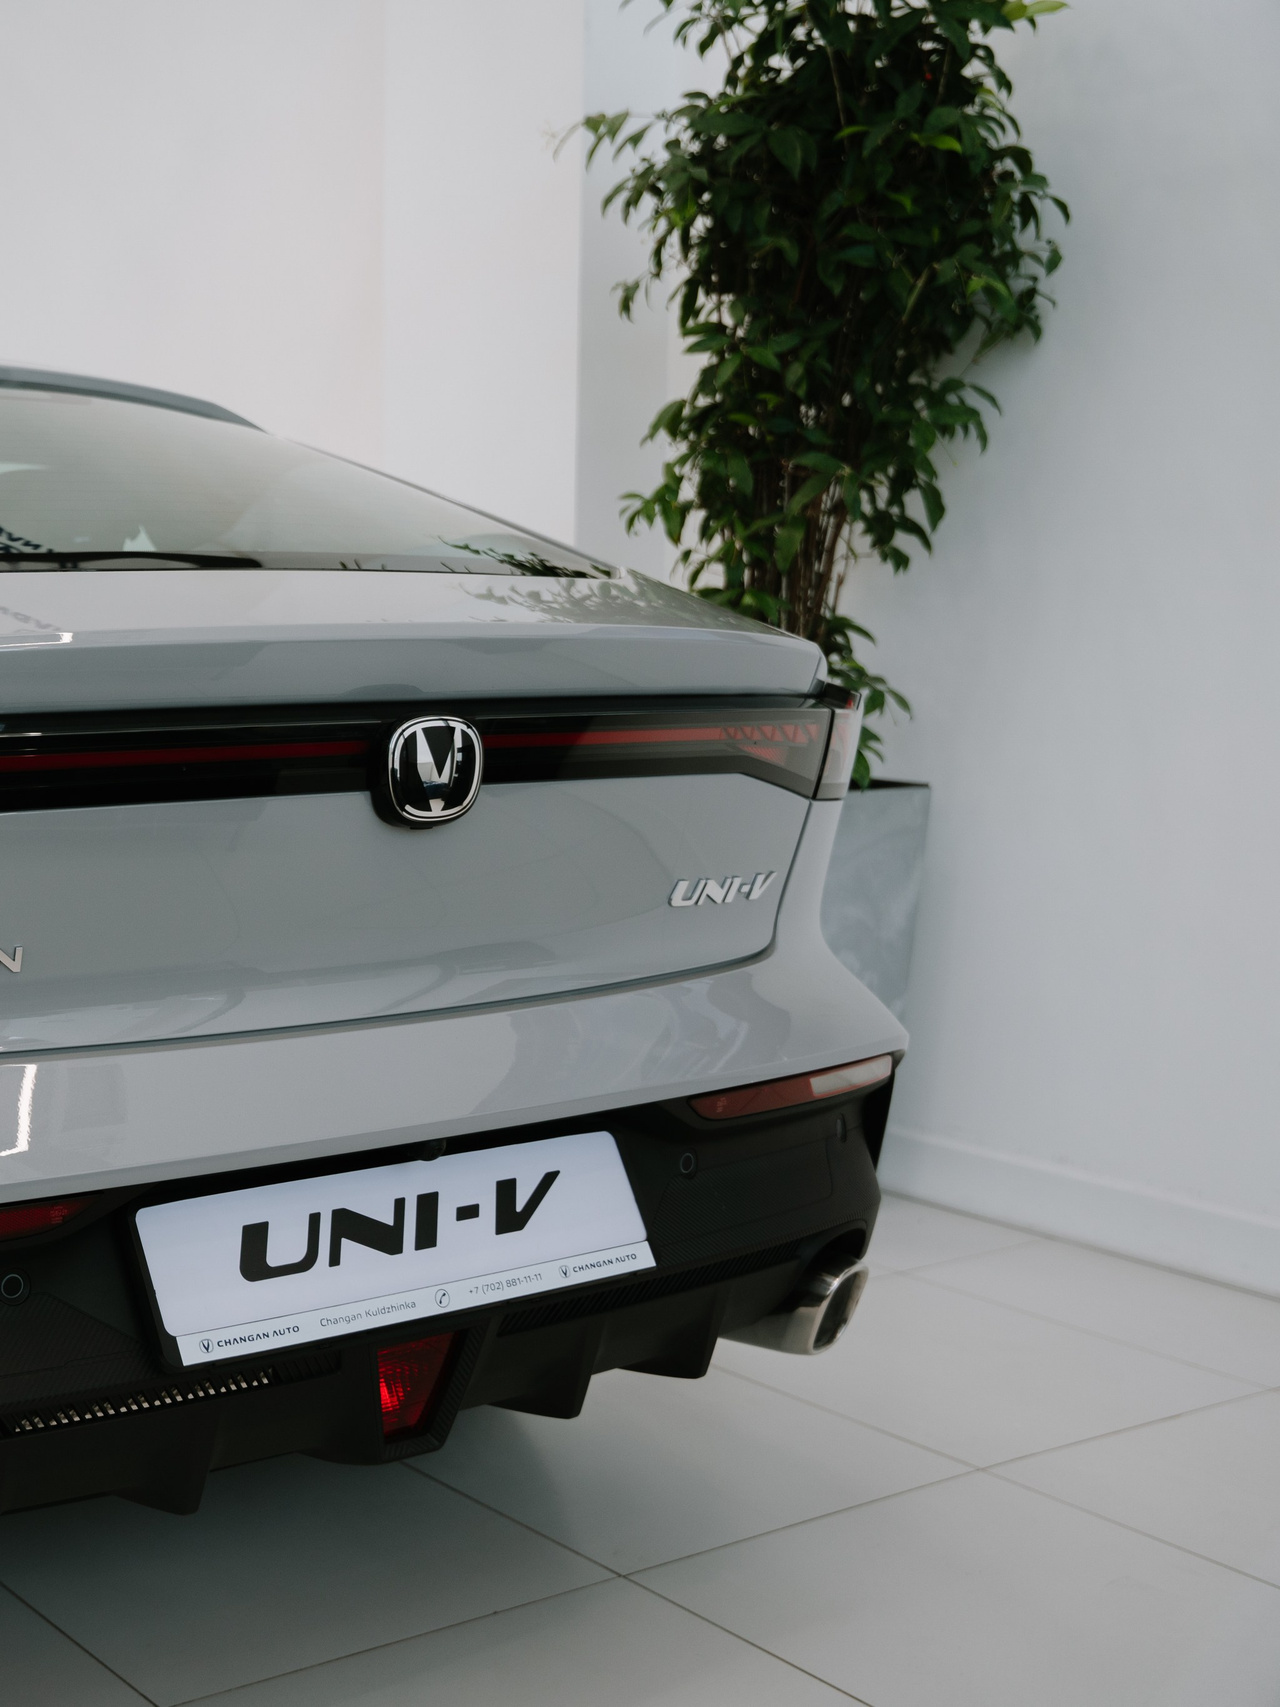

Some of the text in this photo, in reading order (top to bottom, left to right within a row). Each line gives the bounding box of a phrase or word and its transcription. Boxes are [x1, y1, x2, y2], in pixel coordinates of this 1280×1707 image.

[668, 870, 777, 907] UNI-V
[239, 1169, 560, 1282] UNI-V
[573, 1253, 637, 1273] CHANGAN AUTO
[469, 1272, 543, 1296] +7 (702) 881-11-11
[320, 1300, 417, 1328] Changan Kuldzhinka
[217, 1325, 300, 1348] CHANGAN AUTO
